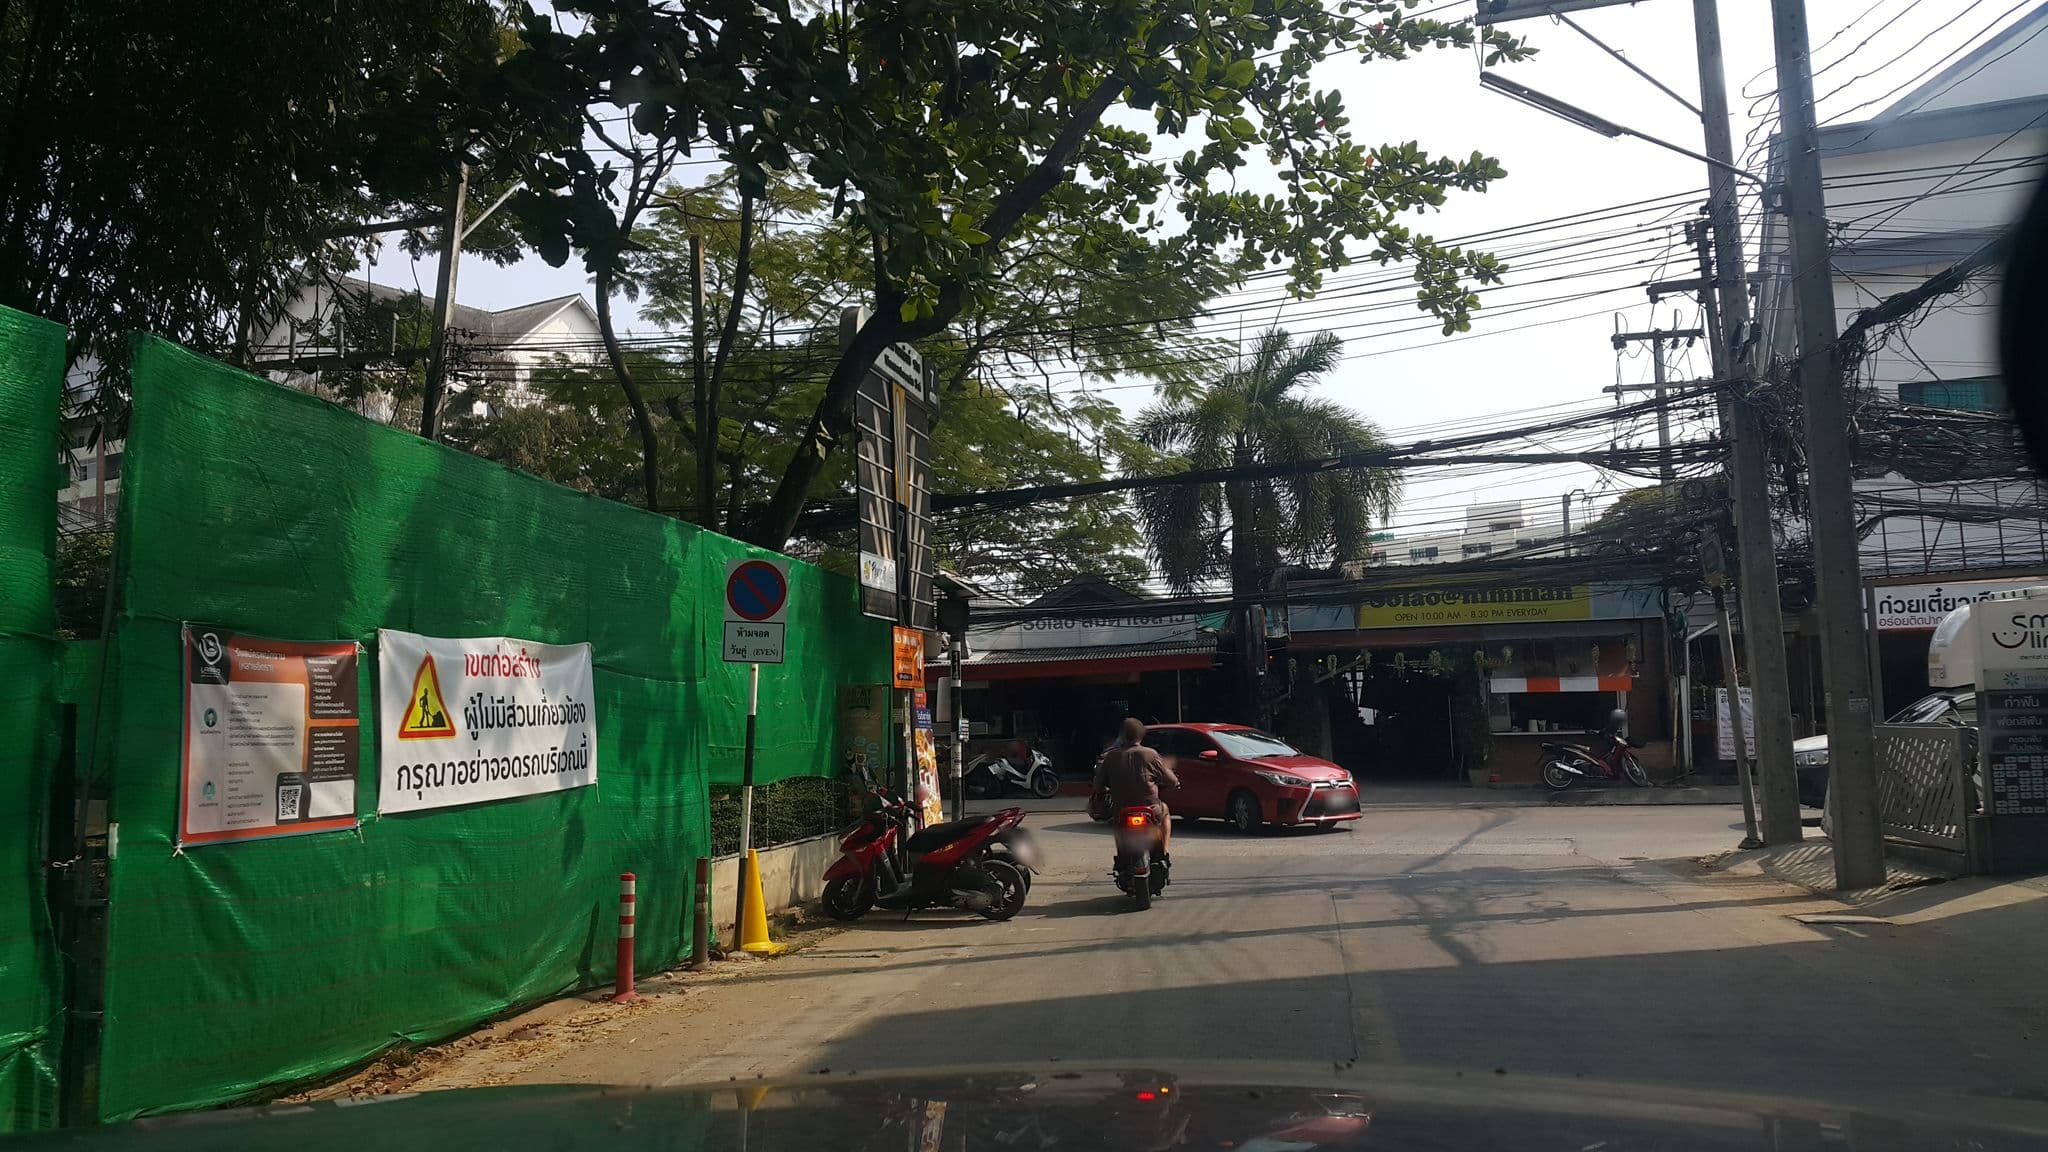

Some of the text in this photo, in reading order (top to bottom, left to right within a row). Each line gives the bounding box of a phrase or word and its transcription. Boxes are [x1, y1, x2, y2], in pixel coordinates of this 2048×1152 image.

[1395, 613, 1418, 622] OPEN
[1447, 612, 1461, 620] AM
[1491, 609, 1505, 618] PM
[1506, 608, 1548, 617] EVERYDAY
[737, 627, 770, 638] ห้ามจอด
[752, 648, 779, 658] (EVEN)
[464, 688, 586, 740] ผู้ไม่มีส่วนเกี่ยวข้อง
[397, 732, 588, 800] กรุณาอย่าจอดรถบริเวณนี้
